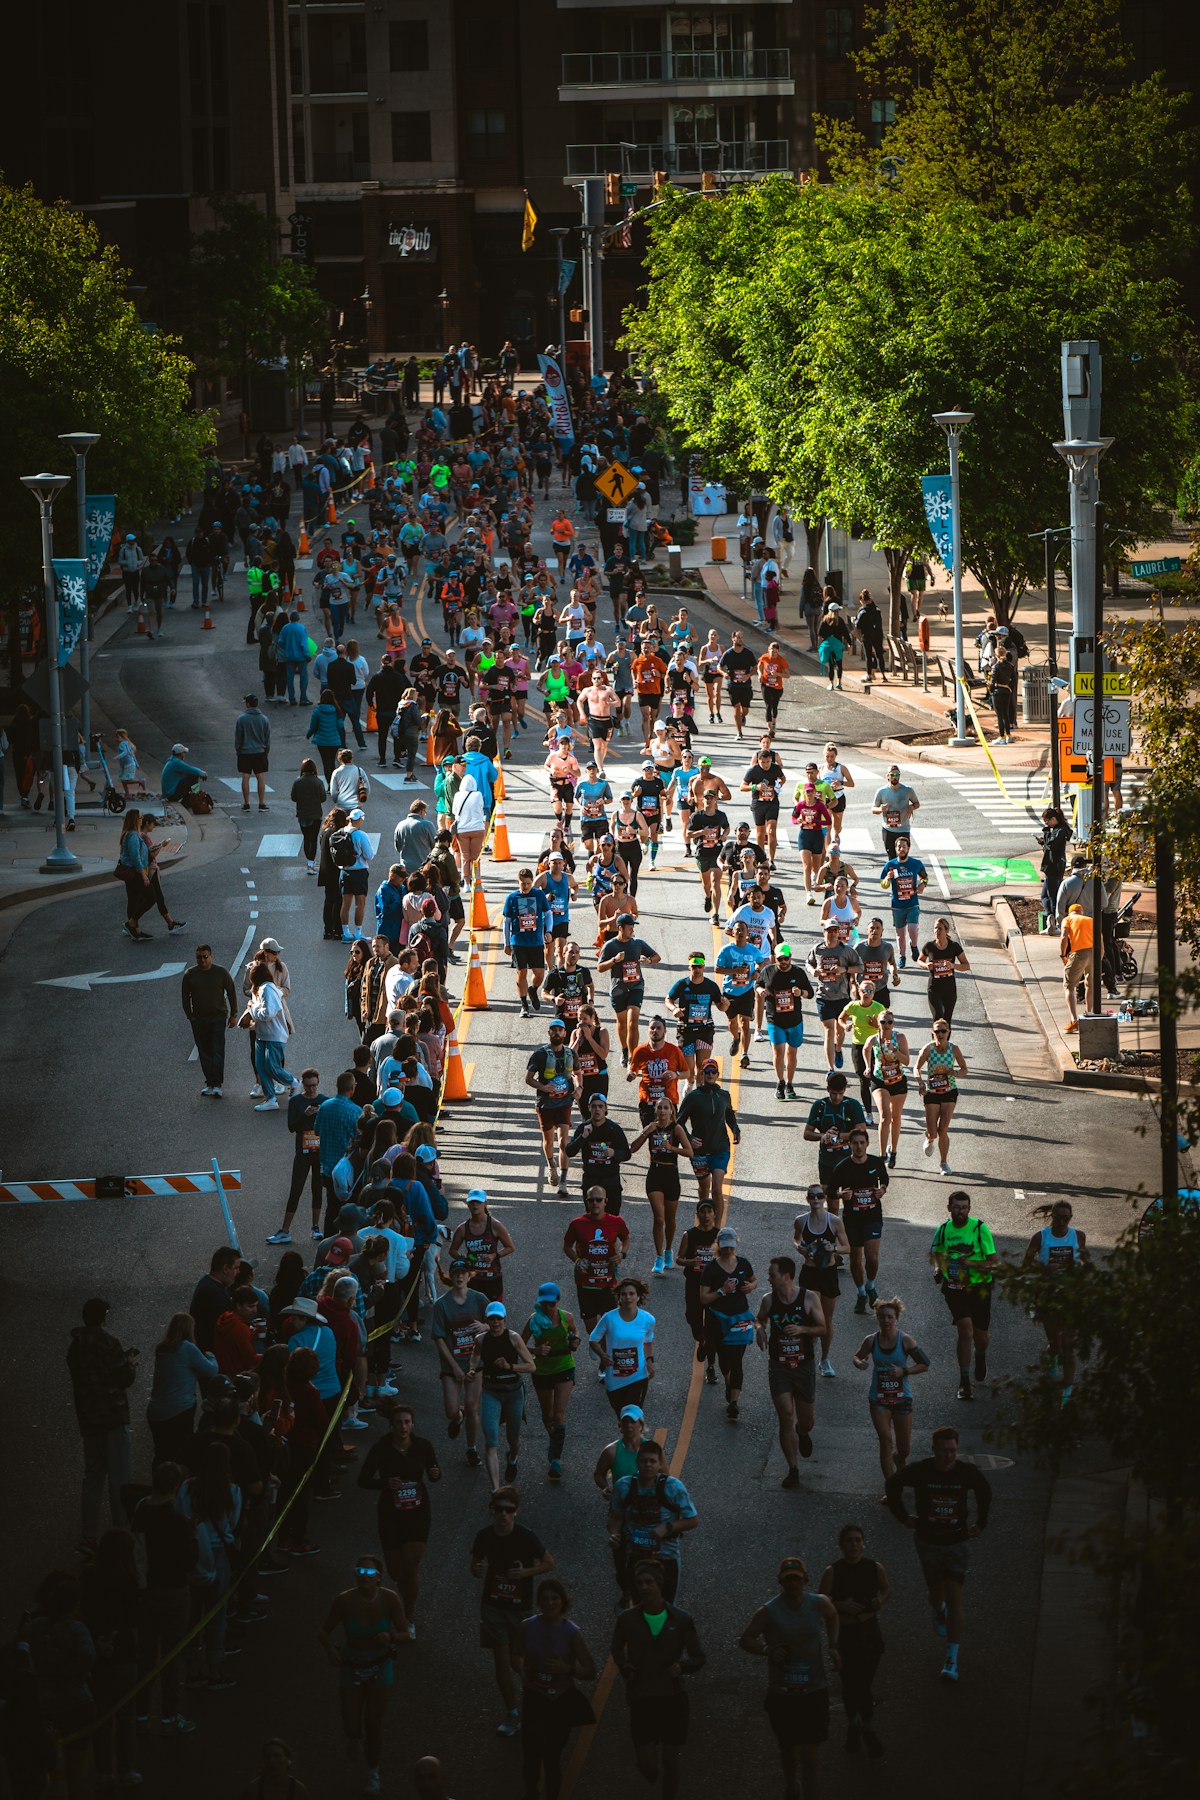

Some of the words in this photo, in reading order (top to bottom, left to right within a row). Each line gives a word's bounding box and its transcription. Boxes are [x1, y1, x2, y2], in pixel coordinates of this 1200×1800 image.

[400, 226, 431, 257] Pub
[940, 492, 950, 555] GULCH
[89, 512, 98, 576] GULCH
[1135, 561, 1168, 577] LAUREL
[60, 577, 72, 649] GULCH
[1106, 730, 1123, 739] USE
[1105, 742, 1127, 753] LANE
[588, 1249, 609, 1257] HERO
[881, 1381, 899, 1389] 2830
